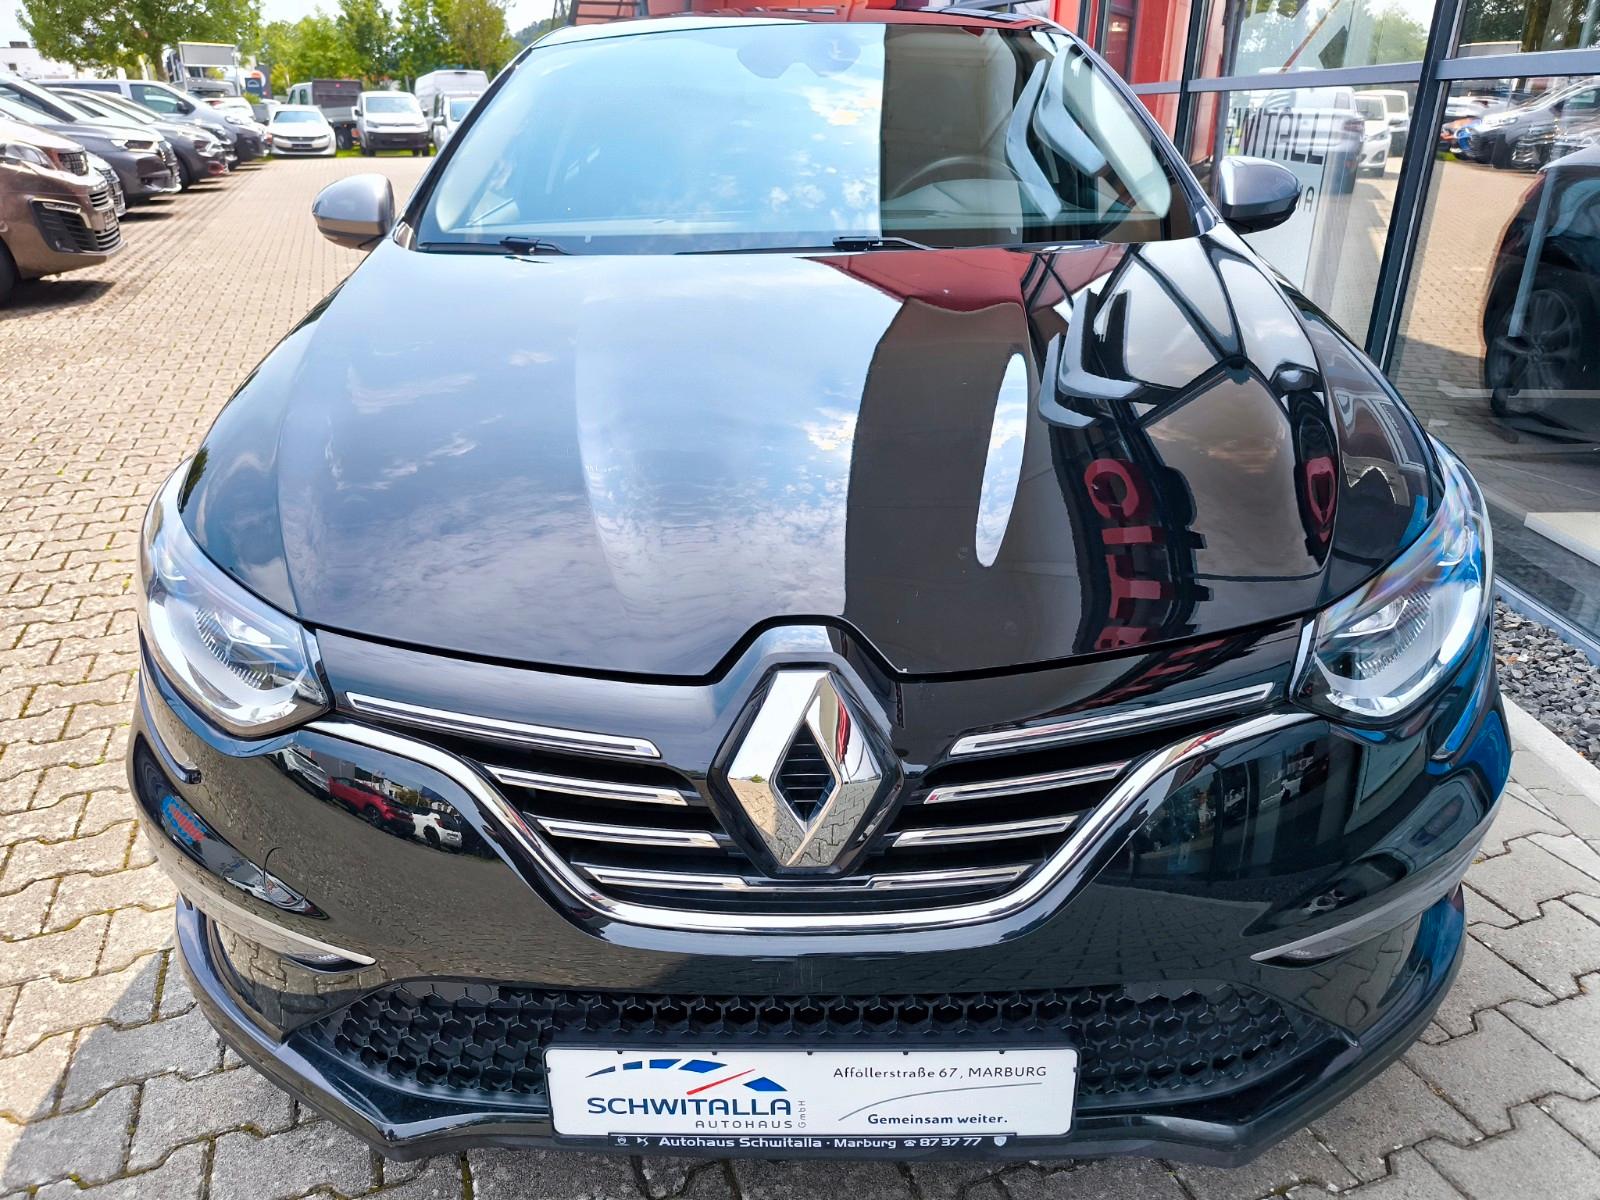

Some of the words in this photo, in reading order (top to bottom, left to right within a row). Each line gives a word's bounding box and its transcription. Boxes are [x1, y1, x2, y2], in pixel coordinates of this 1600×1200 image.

[1232, 107, 1324, 165] WITALL
[833, 1066, 935, 1079] Afföllerstraße
[968, 1066, 1047, 1078] MARBURG
[587, 1097, 791, 1116] SCHWITALLA
[797, 1100, 807, 1128] GmbH
[867, 1113, 953, 1125] Gemeinsam
[957, 1113, 1008, 1124] weiter.
[695, 1120, 793, 1129] AUTOHAUS
[658, 1137, 735, 1148] Autohaus
[739, 1137, 822, 1148] Schwitalla
[834, 1138, 897, 1149] Marburg
